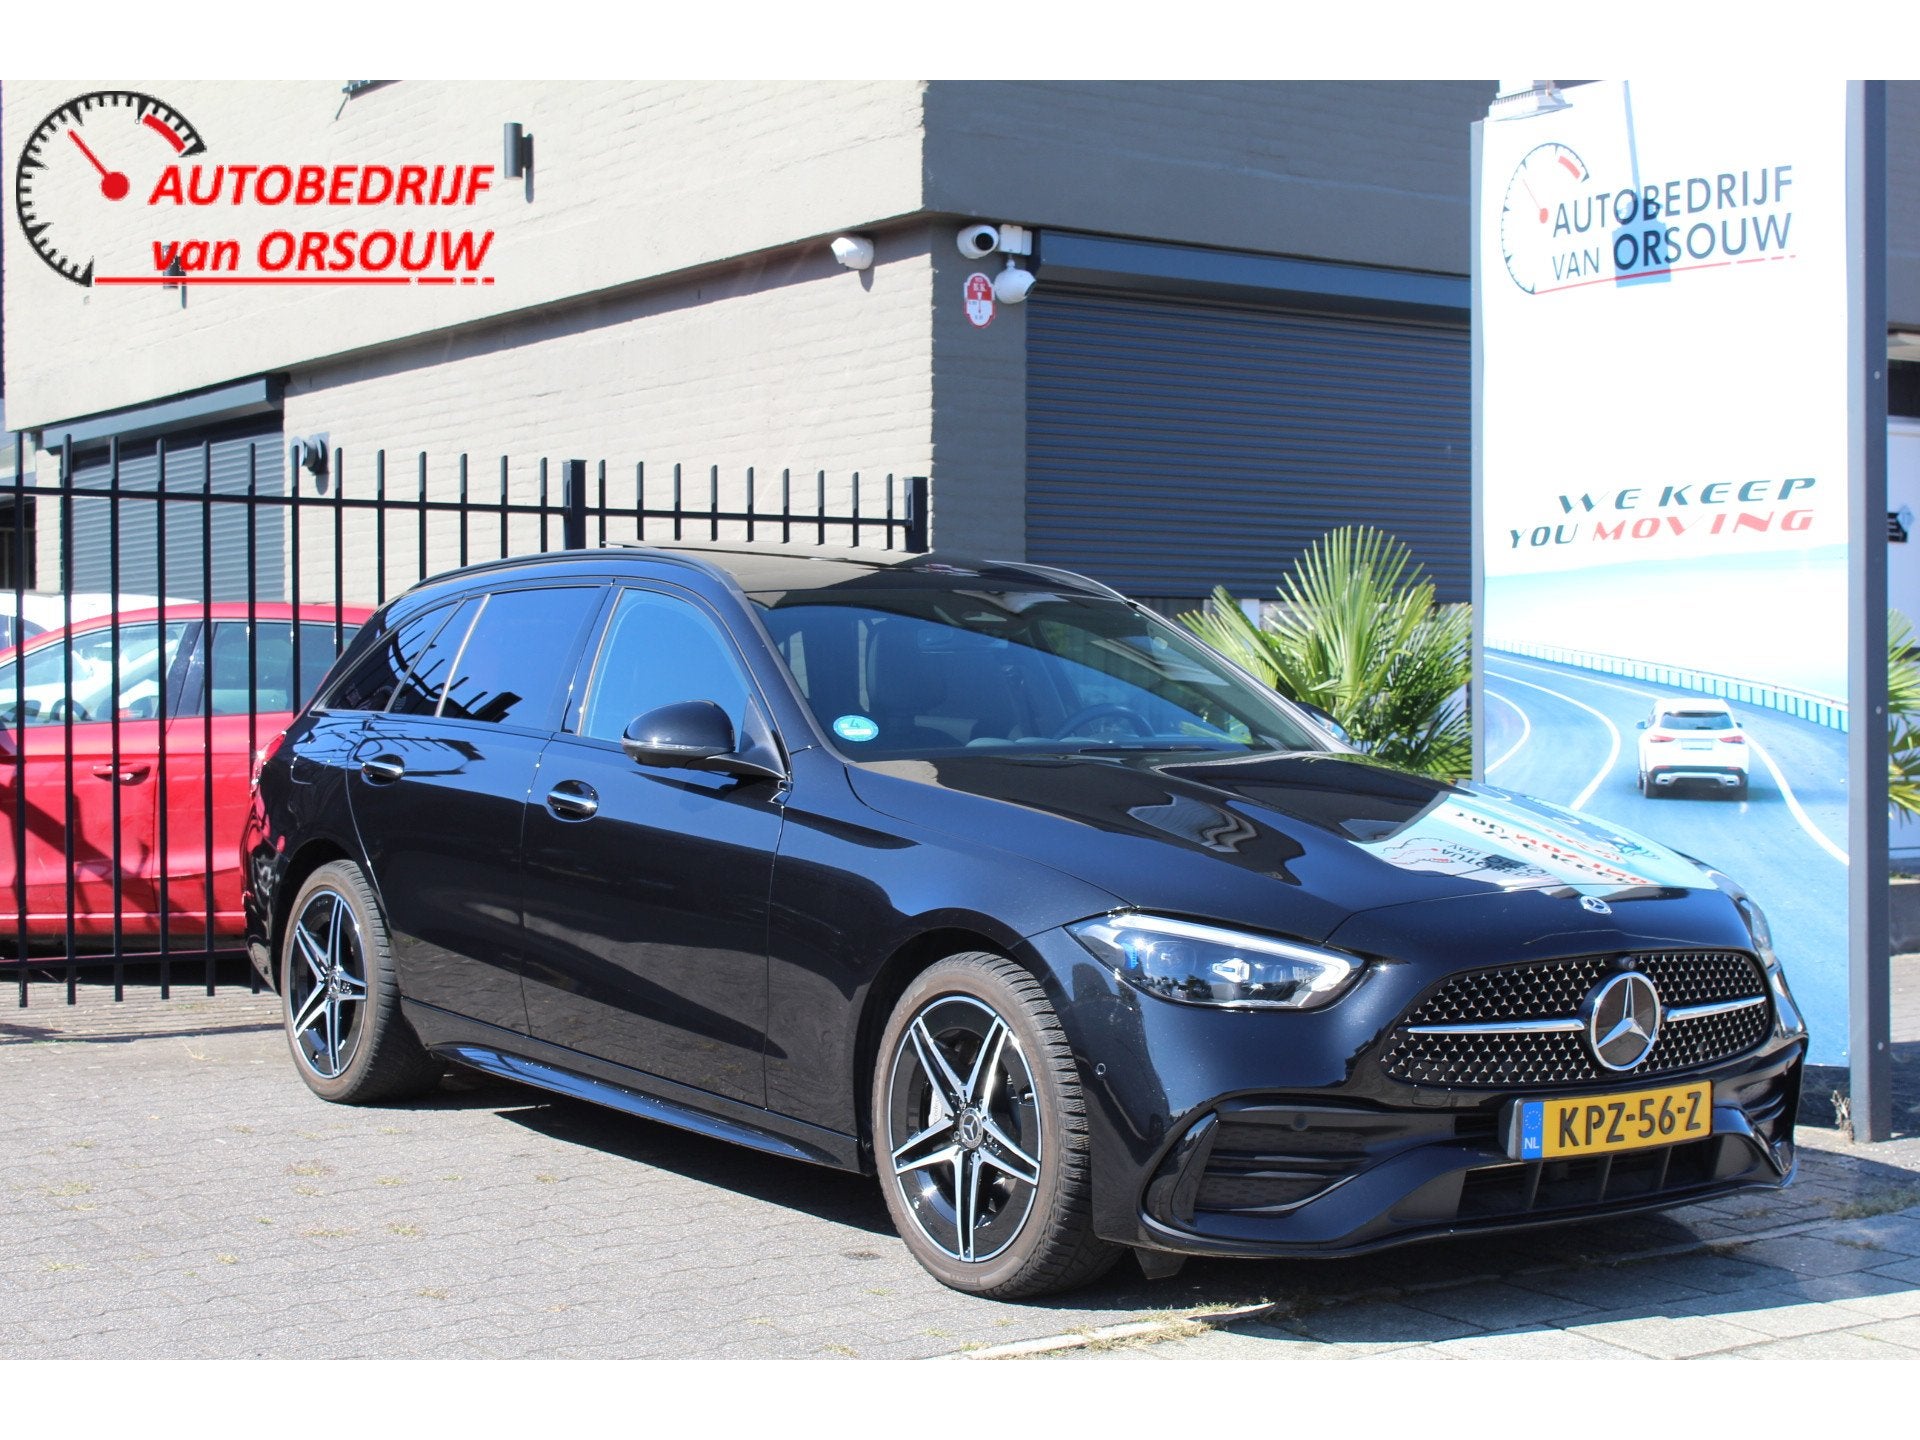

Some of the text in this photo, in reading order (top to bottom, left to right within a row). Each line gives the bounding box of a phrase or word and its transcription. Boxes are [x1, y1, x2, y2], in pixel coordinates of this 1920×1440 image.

[1553, 165, 1792, 238] AUTOBEDRIJF
[1553, 213, 1792, 281] VAN ORSOUW
[1558, 477, 1816, 514] WE KEEP
[1510, 509, 1814, 549] YOU MOVING
[1524, 1137, 1540, 1150] NL
[1559, 1091, 1702, 1148] KPZ-56-Z
